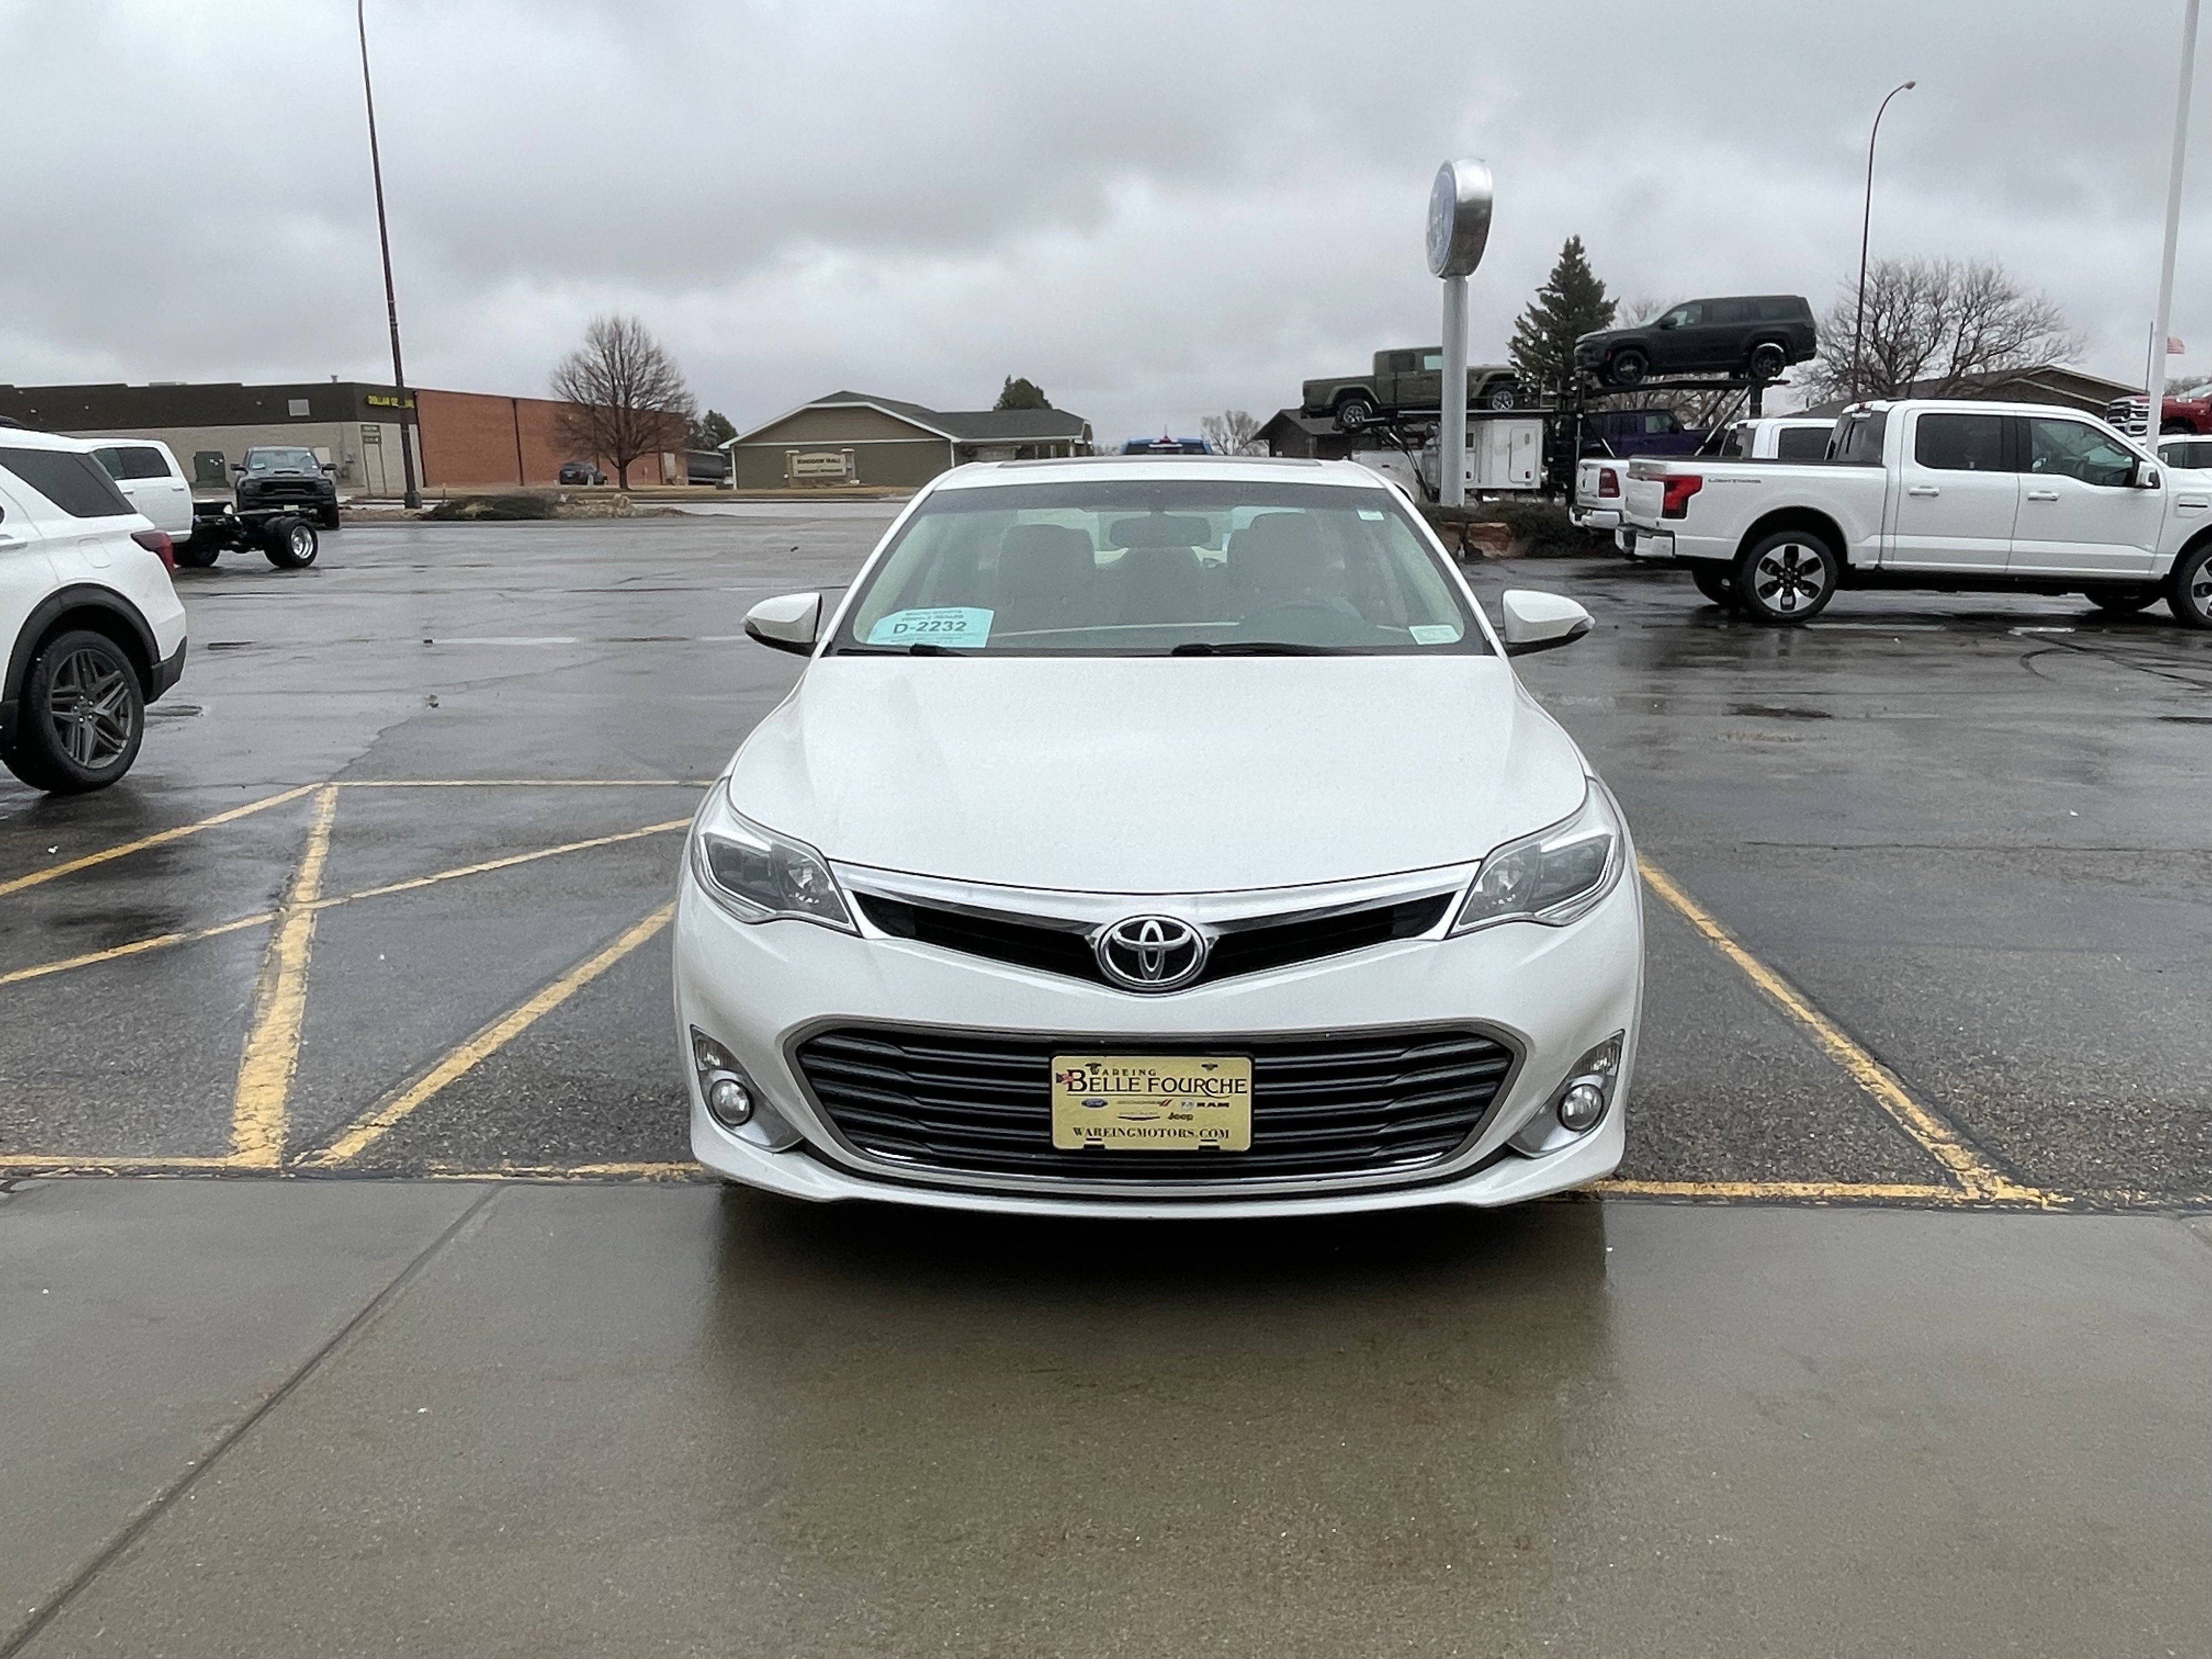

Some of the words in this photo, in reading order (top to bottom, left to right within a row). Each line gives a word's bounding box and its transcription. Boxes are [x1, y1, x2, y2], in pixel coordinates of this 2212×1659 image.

[893, 621, 967, 634] D-2232
[1066, 1069, 1142, 1092] BELLE
[1148, 1076, 1248, 1098] FOURCHE
[1073, 1126, 1229, 1139] WAREINGMOTORS.COM
